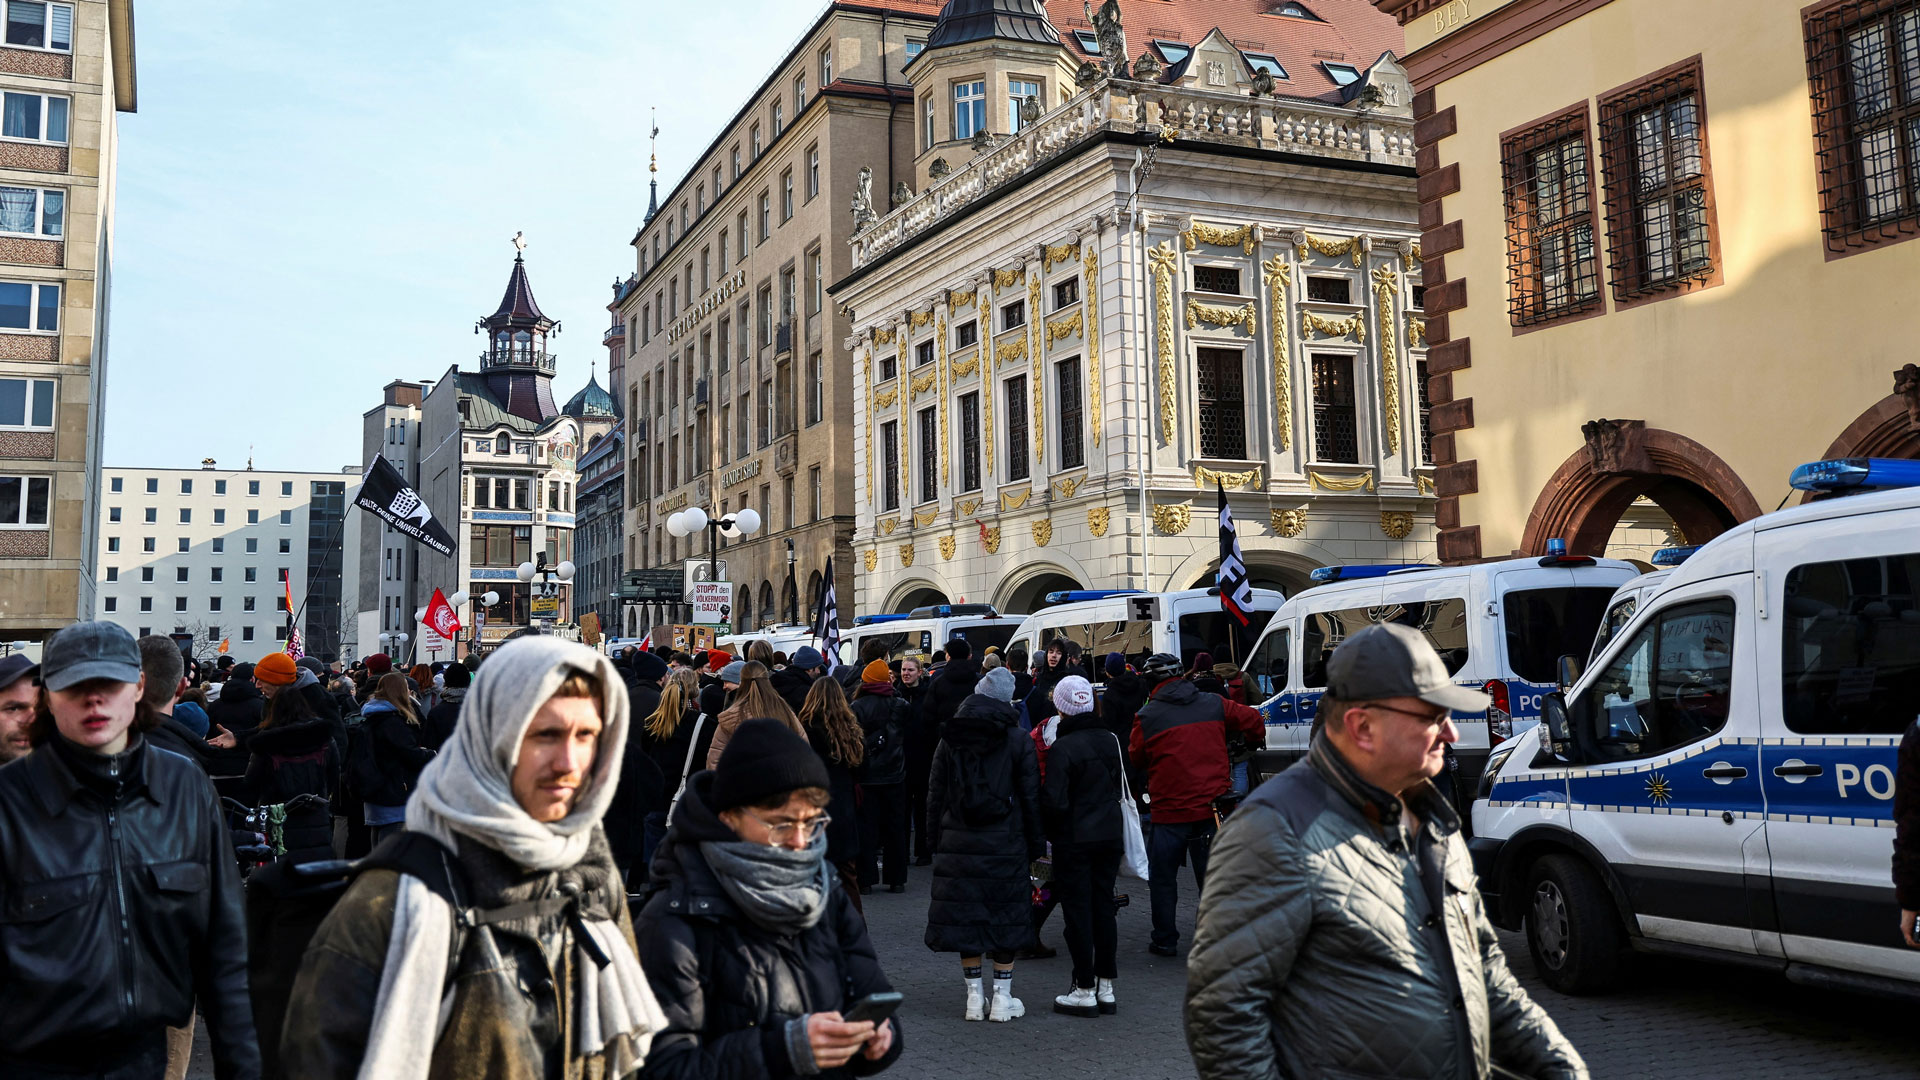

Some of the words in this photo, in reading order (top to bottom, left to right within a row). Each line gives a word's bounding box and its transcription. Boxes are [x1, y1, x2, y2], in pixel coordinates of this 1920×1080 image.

[1434, 0, 1471, 35] BEY
[668, 269, 746, 345] STEIGENBERGER
[721, 459, 763, 489] HANDELSHOF
[360, 498, 377, 511] HALTE
[376, 506, 396, 524] DEINE
[395, 519, 424, 538] UMWELT
[423, 534, 451, 555] SAUBER
[695, 595, 729, 603] VÖLKERMORD
[696, 584, 718, 594] STOPPT
[719, 586, 730, 594] den
[695, 604, 701, 612] in
[702, 603, 719, 612] GAZA!
[1835, 763, 1896, 801] PO
